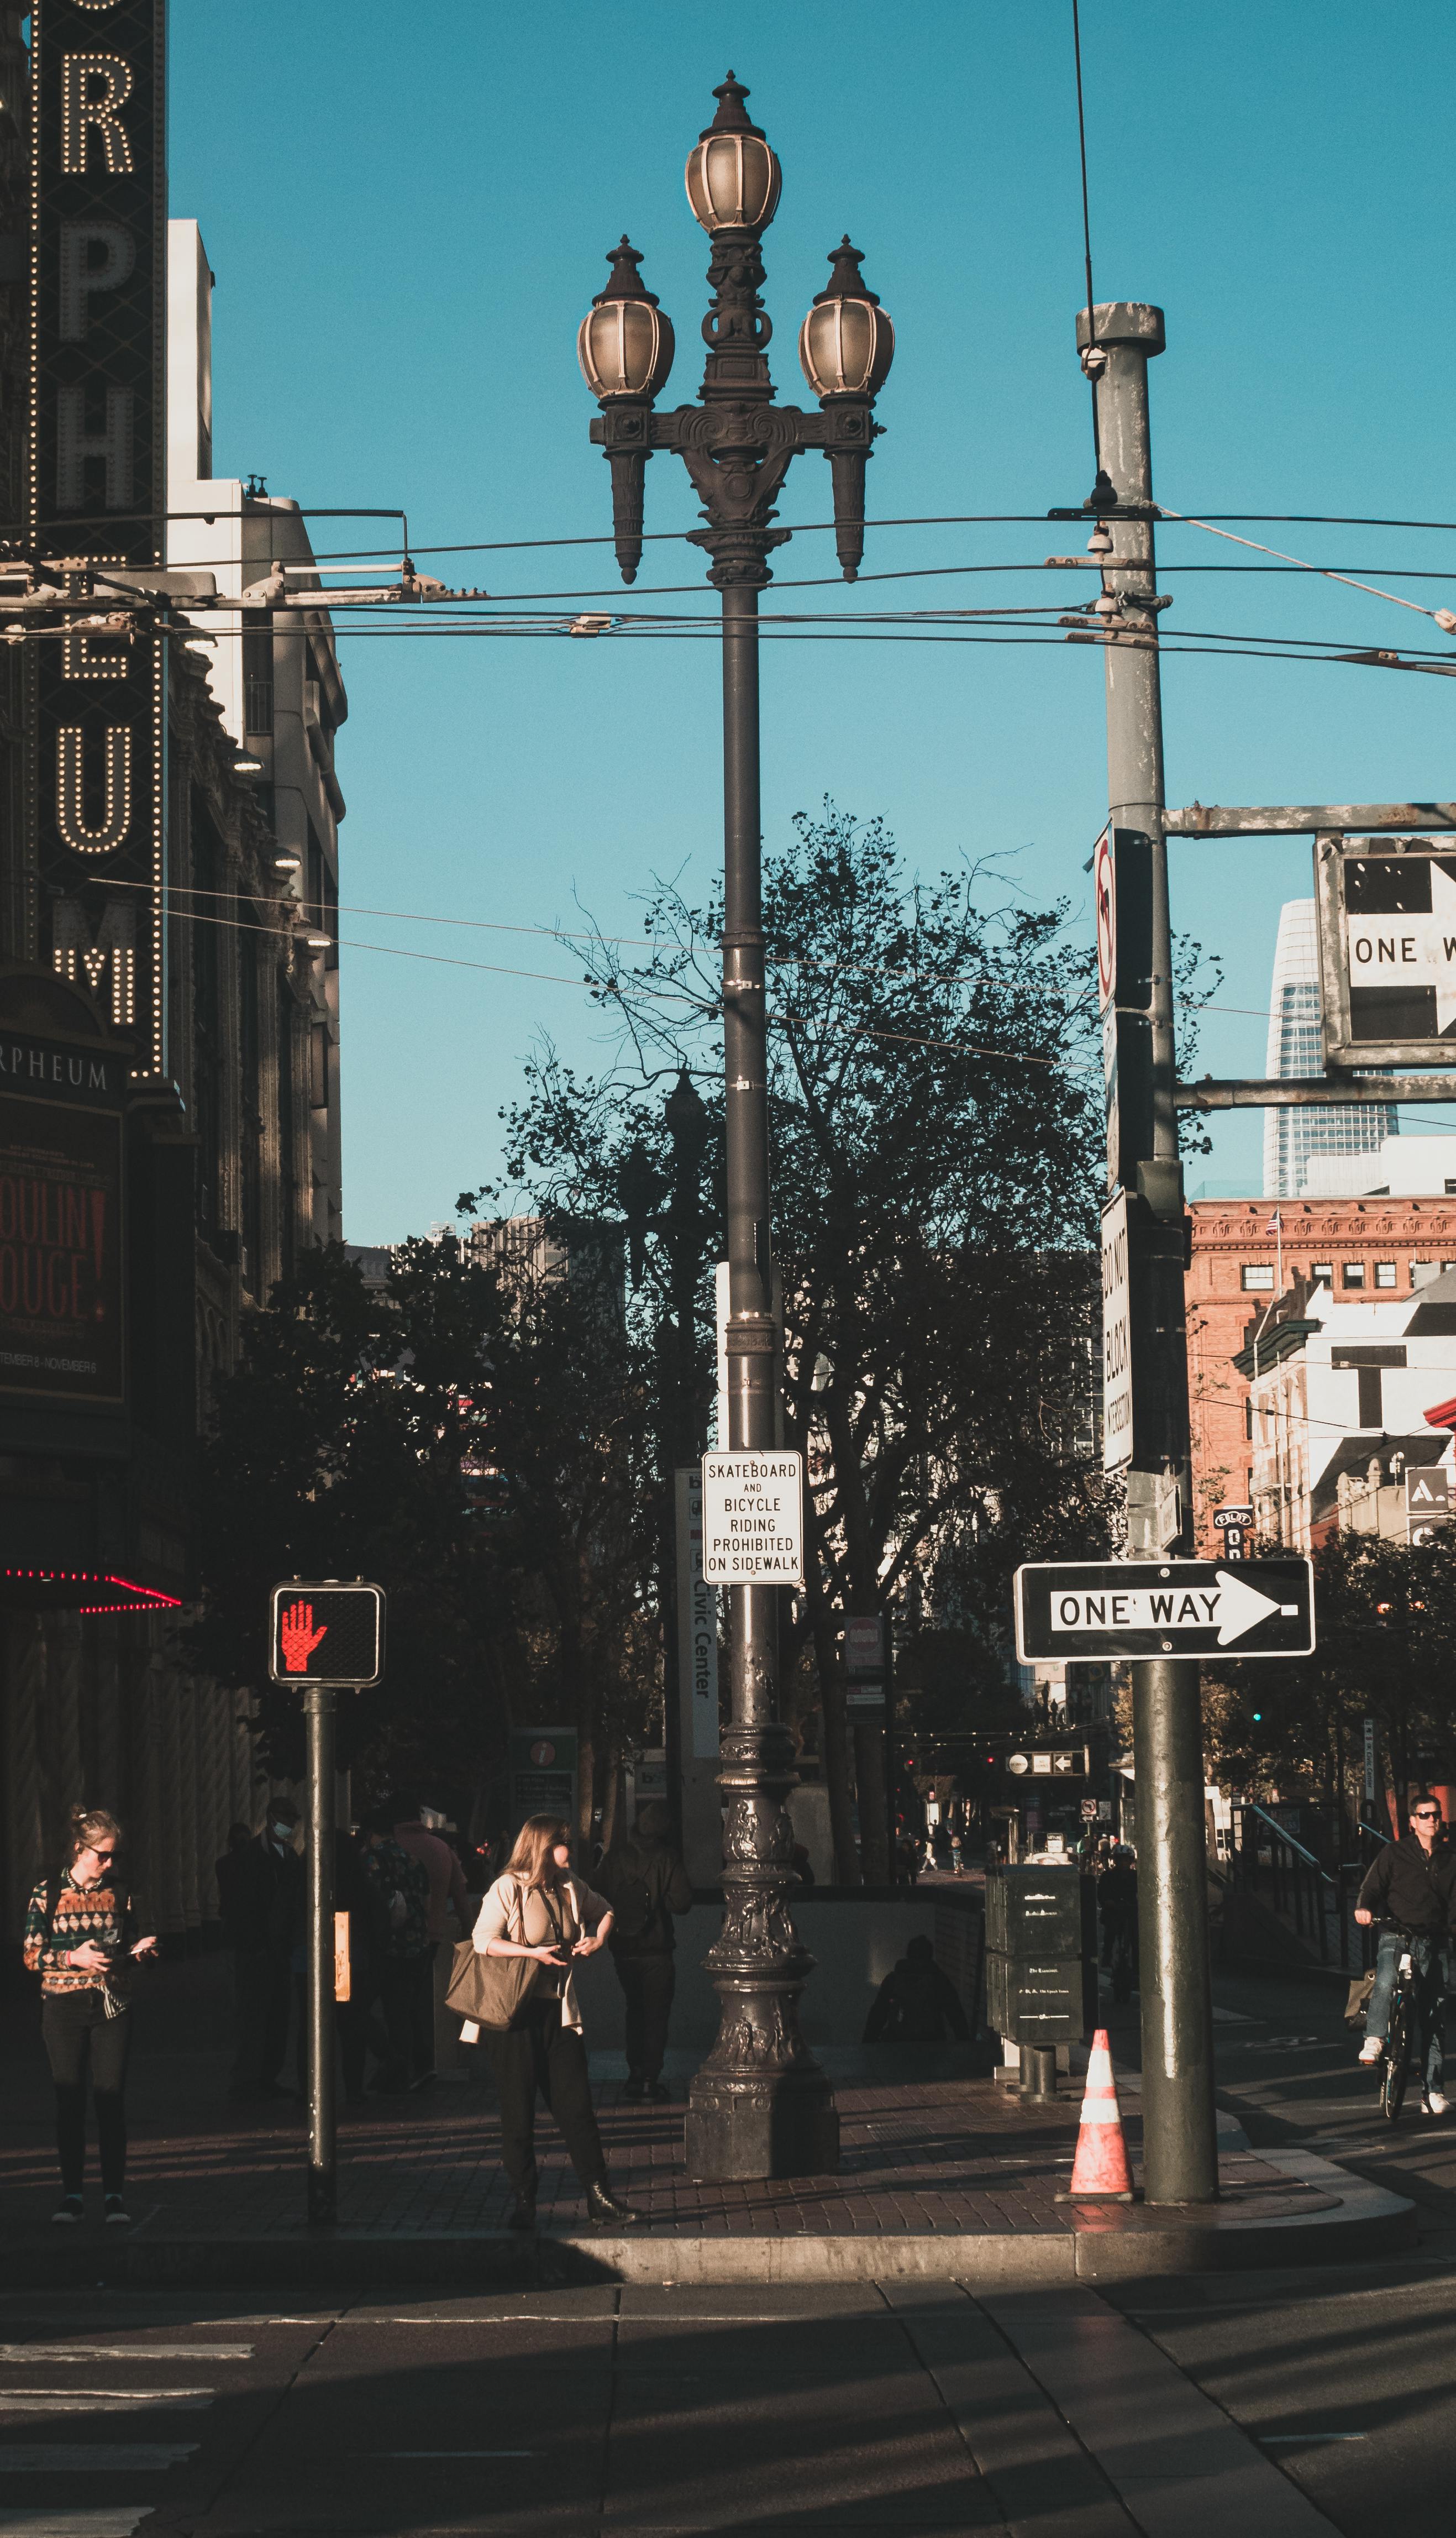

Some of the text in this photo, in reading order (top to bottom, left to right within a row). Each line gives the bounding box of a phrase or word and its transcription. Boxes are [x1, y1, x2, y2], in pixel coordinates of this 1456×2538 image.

[1355, 937, 1417, 963] ONE
[1104, 1227, 1126, 1299] DO NOT
[1106, 1315, 1129, 1383] BLOCK
[45, 1357, 90, 1372] NOVEMBER
[91, 1362, 97, 1374] 6
[708, 1464, 796, 1478] SKATEBOARD
[744, 1483, 762, 1492] AND
[1411, 1478, 1446, 1502] A.
[724, 1498, 781, 1512] BICYCLE
[730, 1519, 776, 1532] RIDING
[713, 1538, 793, 1551] PROHIBITED
[708, 1556, 799, 1570] ON SIDEWALK
[1060, 1593, 1222, 1625] ONE WAY
[694, 1580, 711, 1698] Civic Center
